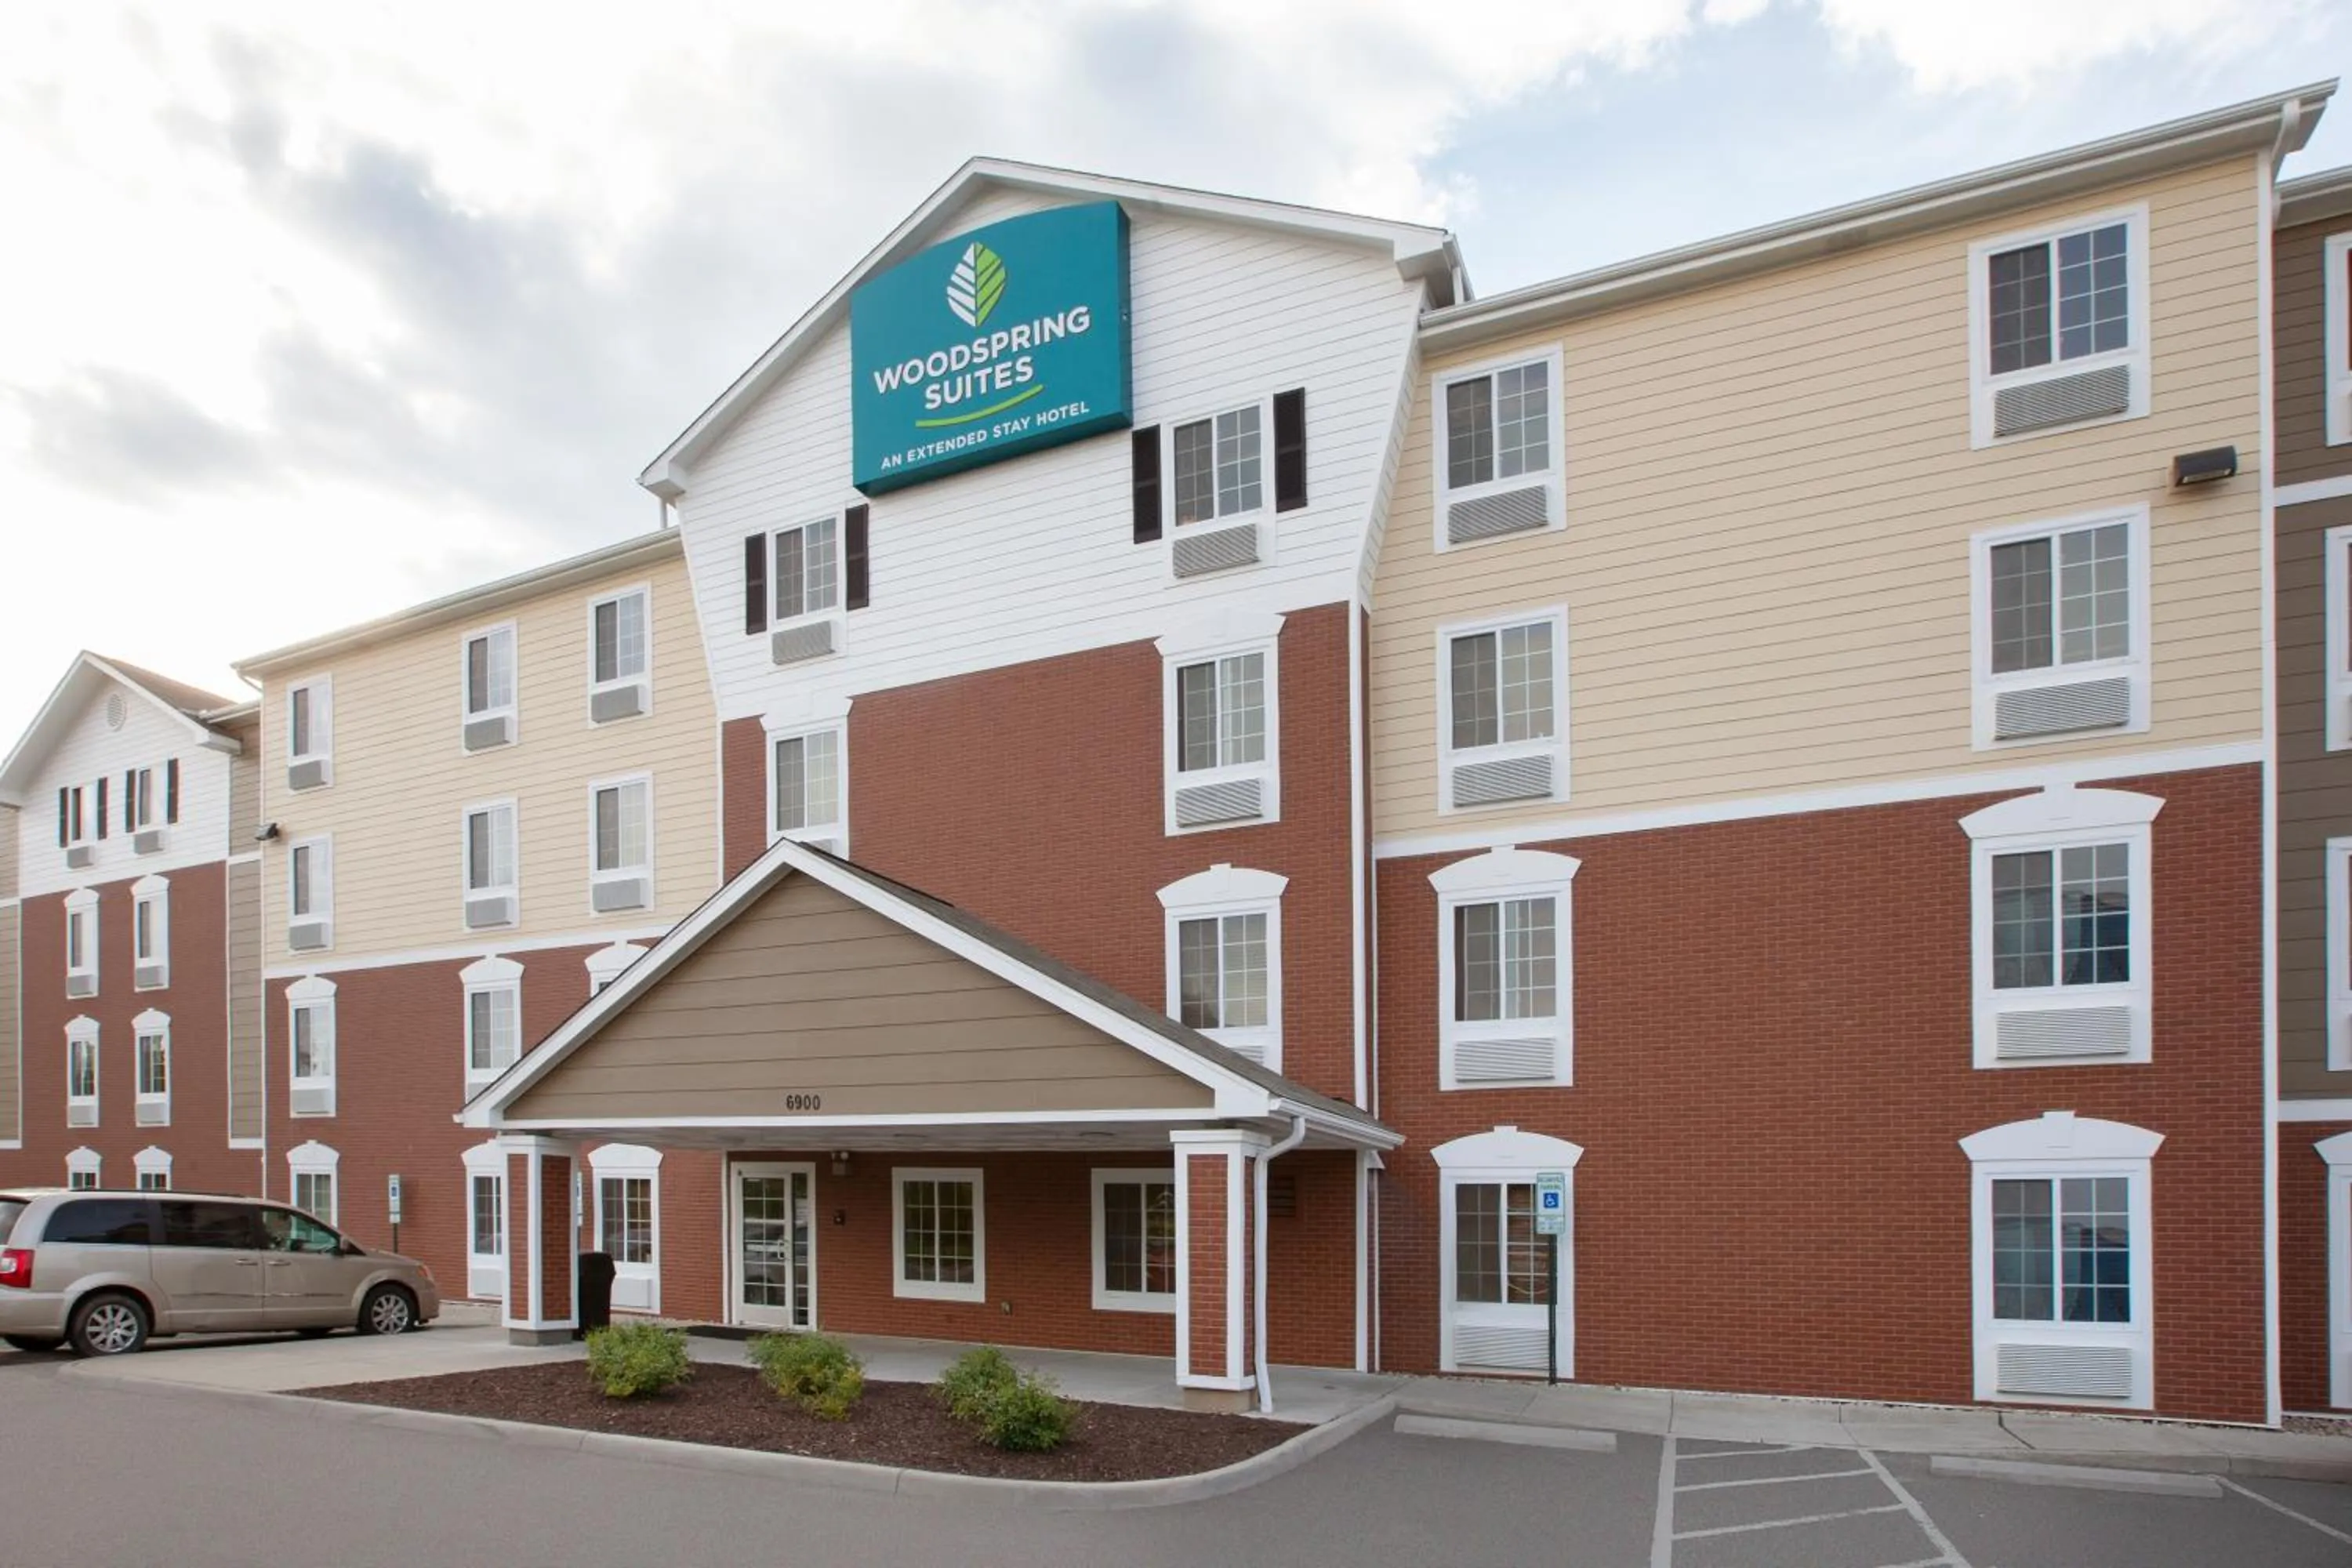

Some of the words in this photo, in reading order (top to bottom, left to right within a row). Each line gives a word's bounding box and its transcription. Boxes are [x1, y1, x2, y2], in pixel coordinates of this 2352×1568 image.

[873, 306, 1091, 394] WOODSPRING
[925, 356, 1034, 410] SUITES
[880, 454, 902, 470] AN
[907, 430, 988, 463] EXTENDED
[993, 416, 1031, 438] STAY
[1036, 401, 1090, 426] HOTEL
[786, 1094, 821, 1110] 6900
